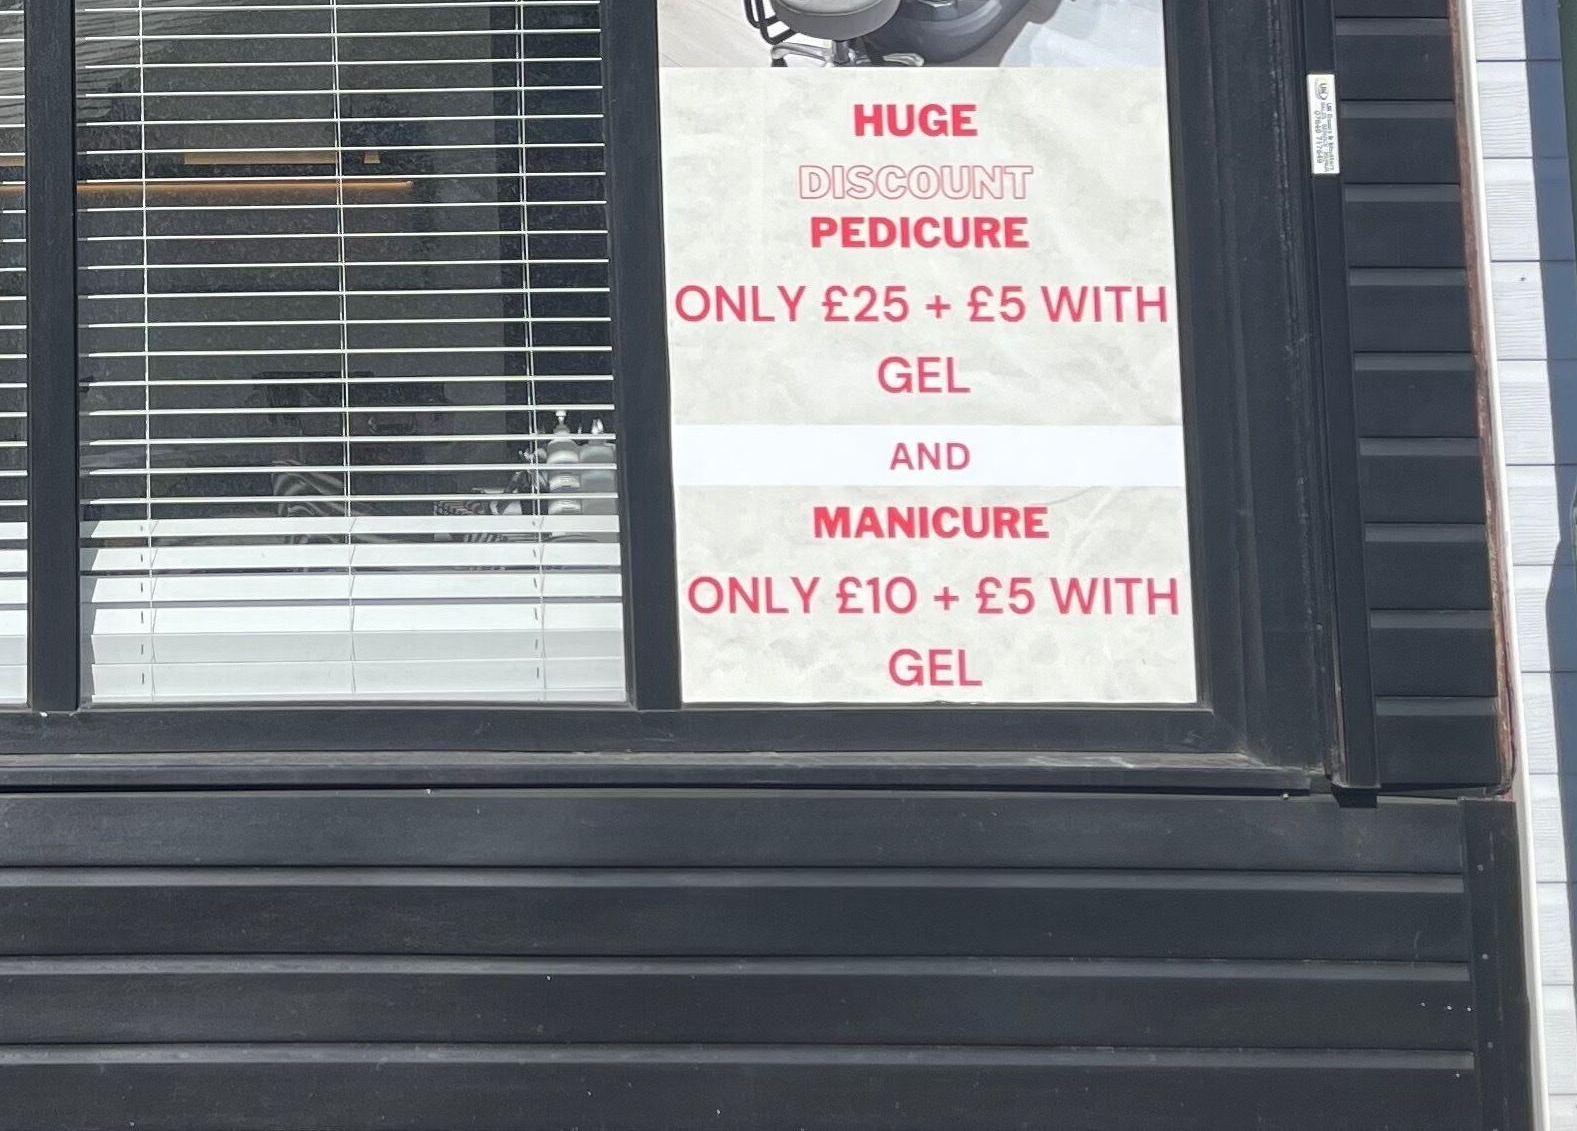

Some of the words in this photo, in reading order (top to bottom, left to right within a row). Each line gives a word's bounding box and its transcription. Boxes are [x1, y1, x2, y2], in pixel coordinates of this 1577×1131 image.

[853, 103, 978, 138] HUGE
[798, 164, 1035, 201] DISCOUNT
[809, 215, 1030, 250] PEDICURE
[674, 284, 806, 324] ONLY
[821, 284, 910, 324] £25
[925, 295, 952, 320] +
[966, 284, 1027, 324] £5
[1039, 285, 1169, 324] WITH
[876, 355, 972, 395] GEL
[889, 441, 971, 472] AND
[812, 504, 1050, 540] MANICURE
[686, 575, 820, 616] ONLY
[835, 575, 918, 616] £10
[933, 586, 960, 611] +
[975, 575, 1036, 616] £5
[1049, 576, 1180, 616] WITH
[887, 647, 983, 687] GEL
